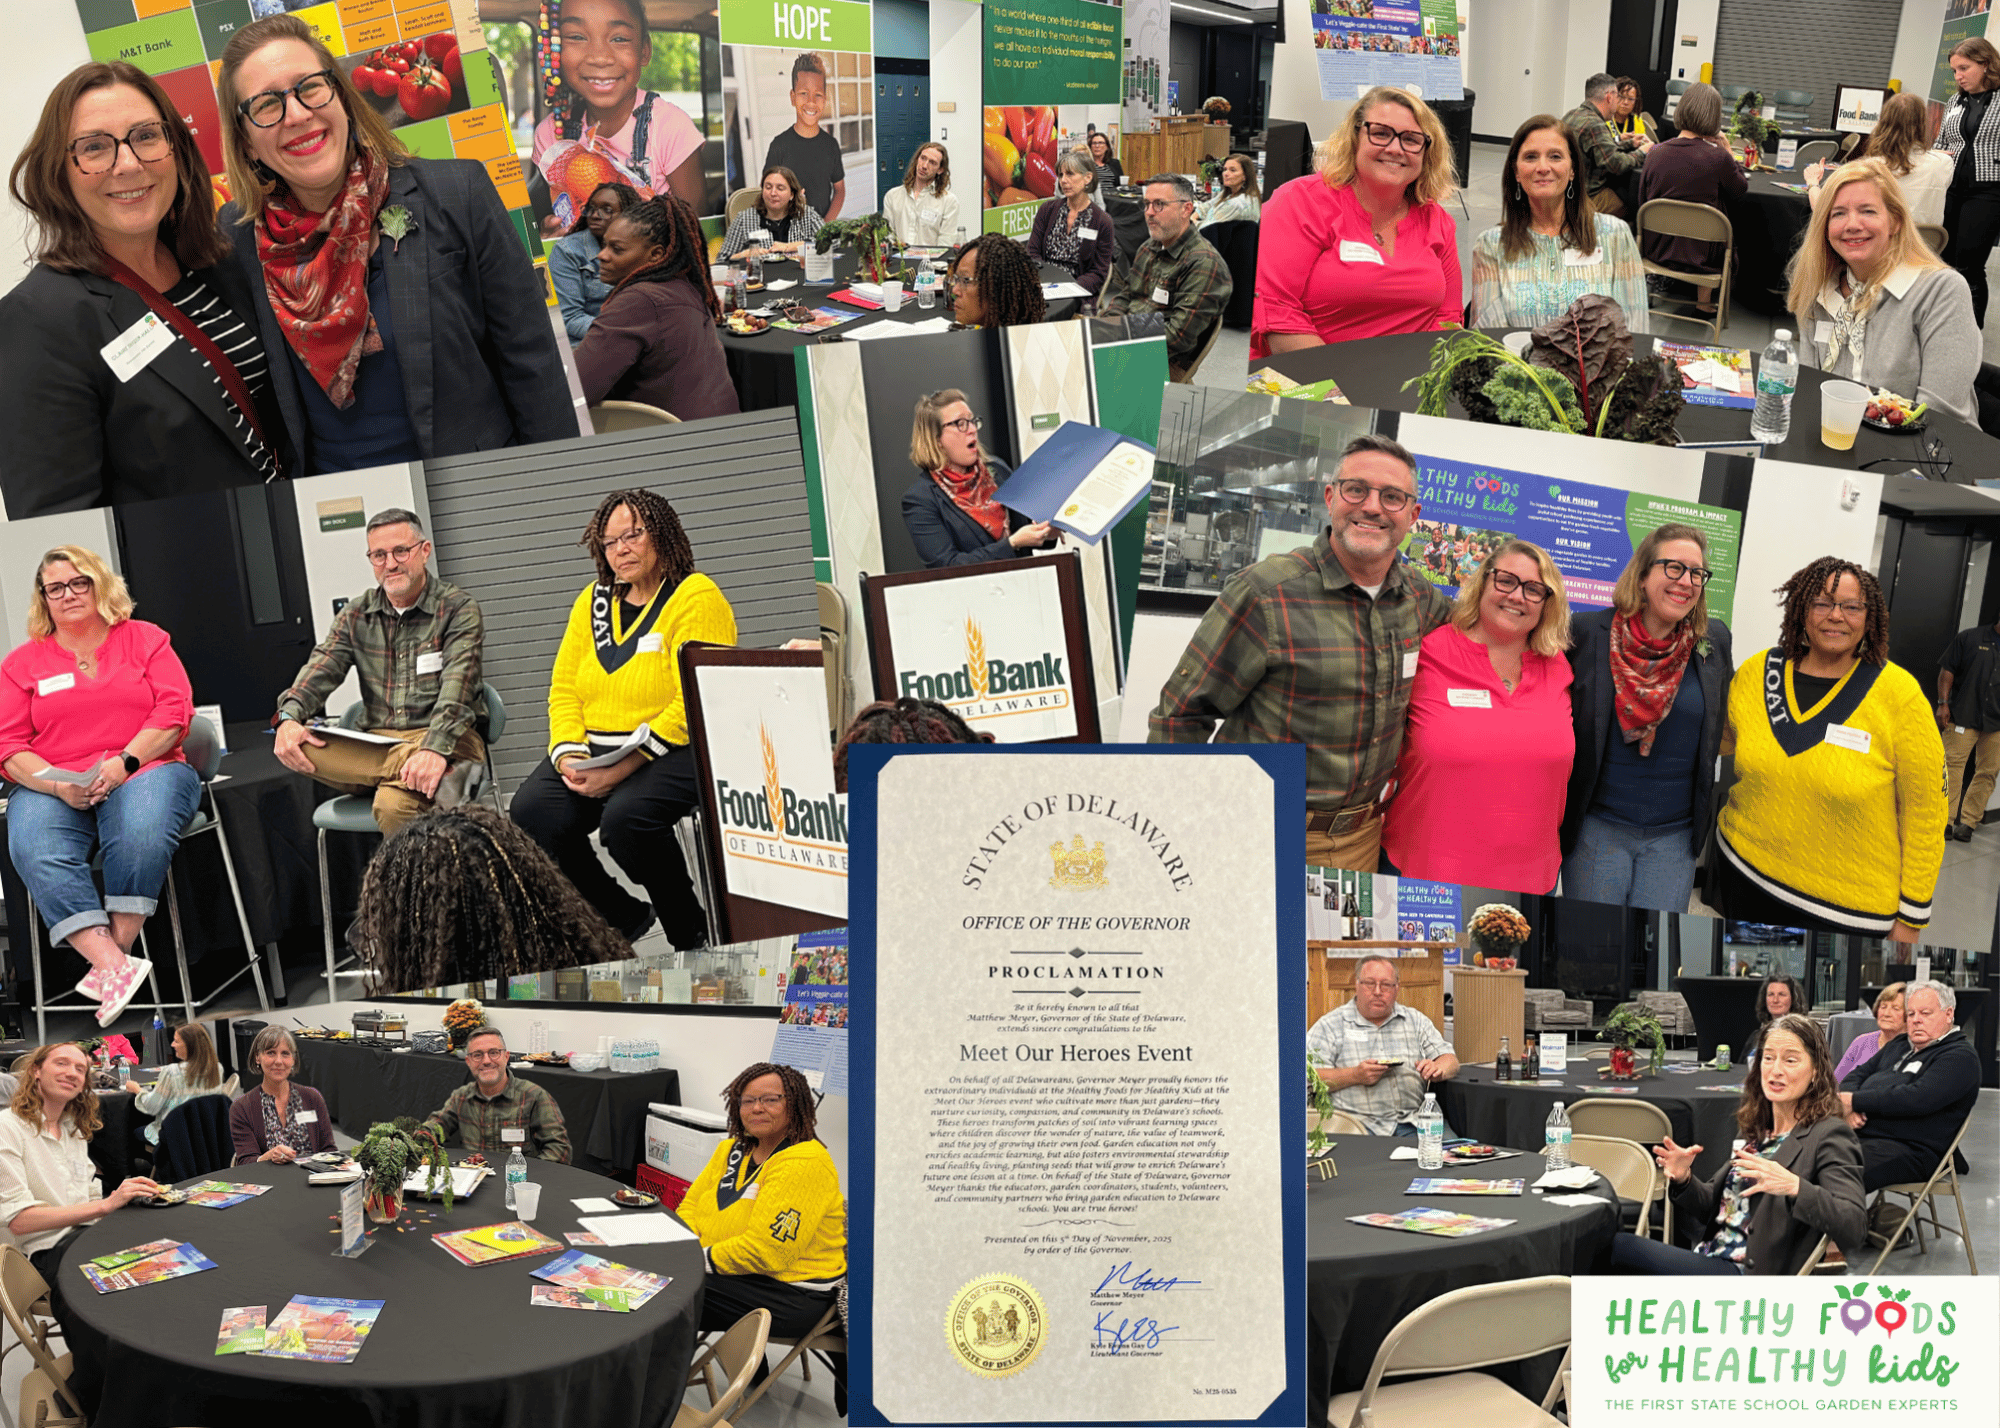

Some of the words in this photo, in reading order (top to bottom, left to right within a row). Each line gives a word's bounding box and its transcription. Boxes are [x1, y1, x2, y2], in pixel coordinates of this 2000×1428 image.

[219, 22, 235, 33] PSX
[774, 2, 832, 42] HOPE
[119, 45, 142, 59] M&T
[145, 38, 173, 53] Bank
[1839, 109, 1857, 120] Food
[1859, 111, 1879, 121] Bank
[1003, 205, 1038, 235] FRESH
[1417, 467, 1458, 487] LTHY
[1466, 475, 1520, 497] FOODS
[1418, 486, 1476, 509] ALTHY
[1482, 495, 1518, 516] kids
[1557, 494, 1571, 502] OUR
[1572, 496, 1599, 508] MISSION
[1671, 504, 1699, 517] PROGRAM
[1705, 511, 1728, 522] IMPACT
[1555, 537, 1568, 546] OUR
[1570, 539, 1592, 550] VISION
[1566, 590, 1590, 600] SCHOOL
[900, 663, 975, 701] Food
[987, 652, 1066, 695] Bank
[951, 693, 1063, 717] DELAWARE
[716, 779, 774, 833] Food
[780, 787, 848, 844] Bank
[962, 814, 1023, 891] STATE
[1023, 795, 1058, 822] OF
[1066, 793, 1193, 893] DELAWARE
[730, 836, 747, 852] OF
[757, 841, 848, 870] DELAWARE
[1406, 895, 1437, 905] HEALTHY
[962, 916, 1025, 930] OFFICE
[1029, 916, 1054, 930] OF
[1056, 916, 1092, 930] THE
[1095, 916, 1191, 931] GOVERNOR
[988, 965, 1165, 979] PROCLAMATION
[1013, 1003, 1025, 1011] Be
[1026, 1003, 1034, 1011] it
[1035, 1003, 1065, 1014] hereby
[1066, 1003, 1096, 1011] known
[1097, 1003, 1107, 1011] to
[1108, 1003, 1121, 1011] all
[1120, 1003, 1139, 1011] that
[966, 1013, 1005, 1022] Matthew
[1008, 1013, 1039, 1024] Meyer,
[1040, 1013, 1079, 1023] Governor
[1082, 1013, 1091, 1024] of
[1092, 1013, 1107, 1022] the
[1108, 1013, 1130, 1022] State
[1131, 1013, 1141, 1024] of
[1142, 1013, 1187, 1024] Delaware,
[996, 1024, 1029, 1032] extends
[1063, 1024, 1131, 1035] congratulations
[1132, 1024, 1141, 1032] to
[1142, 1024, 1157, 1032] the
[960, 1044, 1009, 1062] Meet
[1015, 1044, 1054, 1062] Our
[1060, 1045, 1131, 1062] Heroes
[1137, 1045, 1193, 1062] Event
[983, 1235, 1027, 1243] Presented
[1040, 1234, 1057, 1243] this
[1070, 1234, 1091, 1245] Day
[1092, 1234, 1101, 1245] of
[1102, 1234, 1151, 1245] November,
[1023, 1245, 1035, 1256] by
[1036, 1245, 1061, 1254] order
[1062, 1245, 1071, 1256] of
[1073, 1245, 1087, 1253] the
[1088, 1245, 1132, 1254] Governor.
[1122, 1292, 1145, 1300] Meyer
[1003, 1285, 1038, 1324] GOVERNOR
[959, 1342, 981, 1363] STATE
[982, 1360, 995, 1368] OF
[997, 1336, 1036, 1368] DELAWARE
